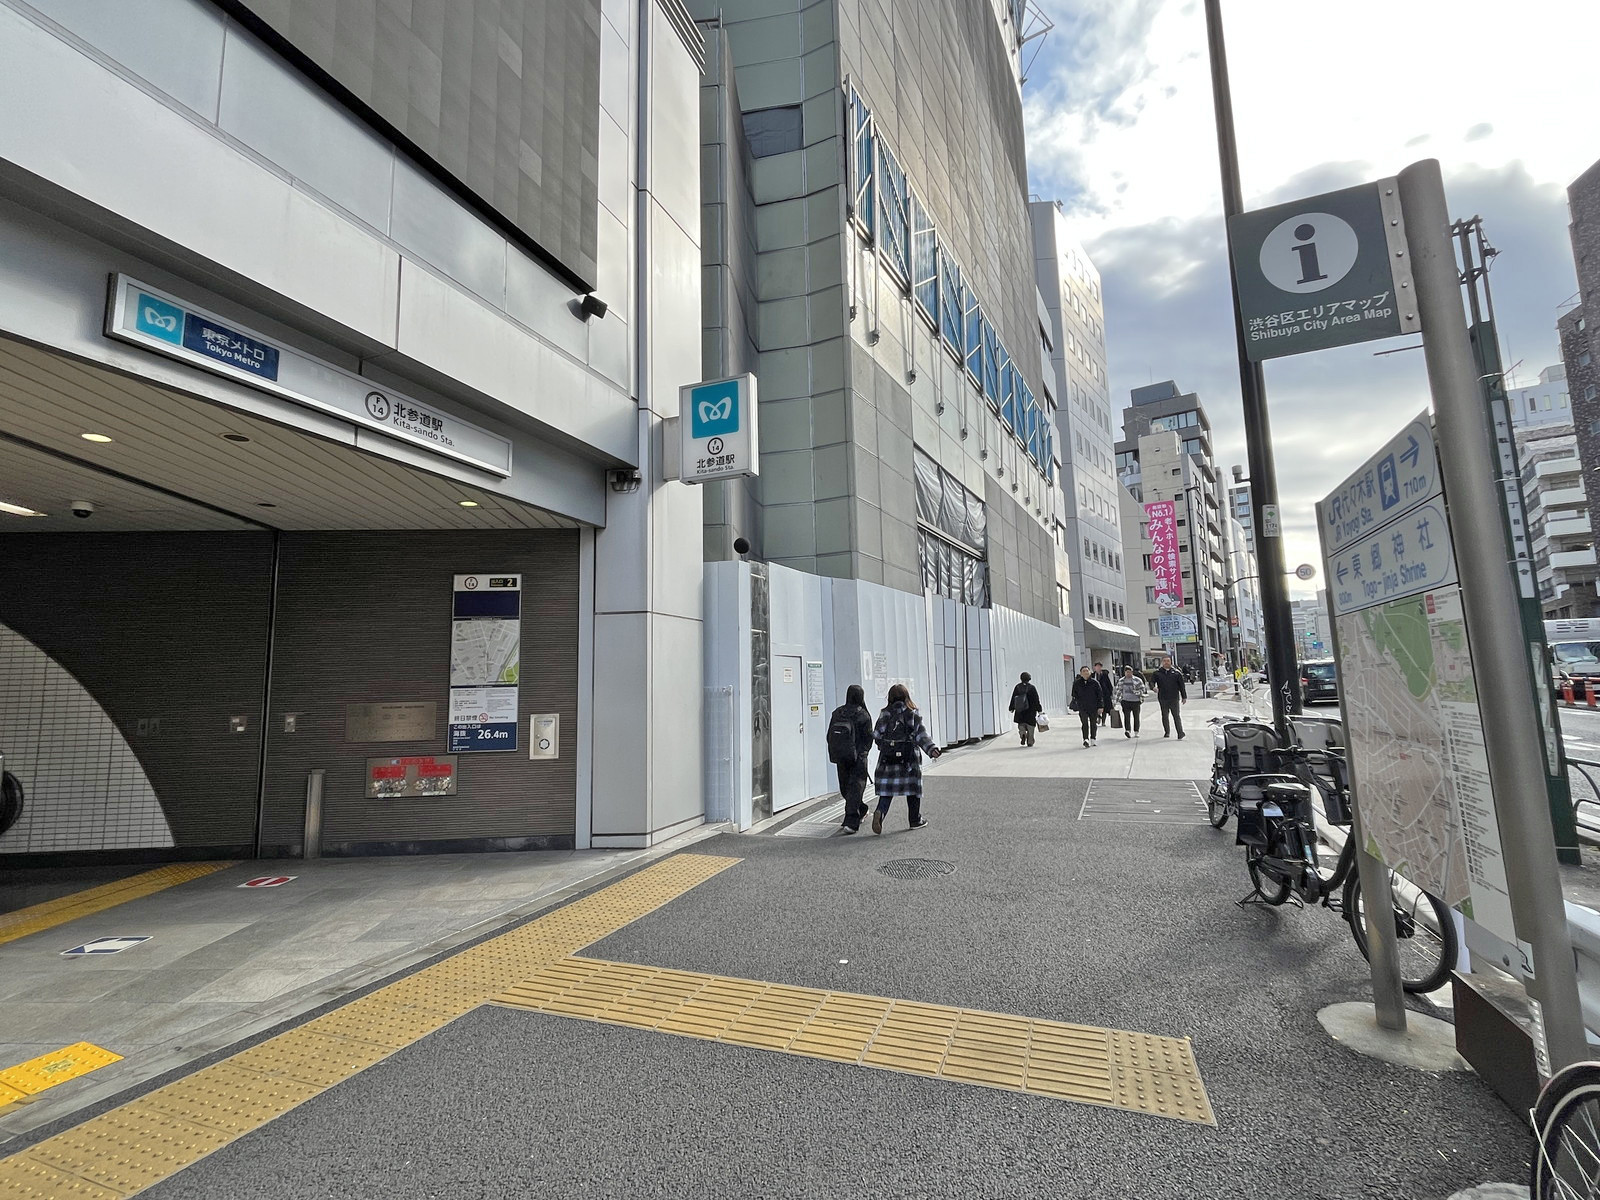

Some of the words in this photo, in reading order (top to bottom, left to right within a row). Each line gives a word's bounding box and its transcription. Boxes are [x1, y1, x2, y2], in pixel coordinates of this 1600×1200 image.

[1249, 291, 1390, 331] 渋谷区エリアマップ
[1251, 322, 1300, 341] Shibuya
[1303, 318, 1328, 331] City
[1331, 312, 1361, 326] Area
[1364, 306, 1392, 320] Map
[202, 327, 265, 360] 東京メトロ
[205, 341, 232, 357] Tokyo
[234, 352, 260, 369] Metro
[373, 404, 384, 415] 14
[394, 402, 443, 433] 北参道駅
[393, 417, 439, 441] Kita-sando
[440, 435, 456, 447] Sta.
[697, 454, 735, 469] 北参道駅
[1328, 469, 1377, 526] JR代々木駅
[1403, 475, 1427, 499] 710m
[1150, 519, 1169, 590] みんなの介護
[506, 578, 513, 587] 2
[1300, 568, 1312, 577] 50
[1400, 560, 1428, 585] Shrine
[477, 729, 508, 740] 26.4m
